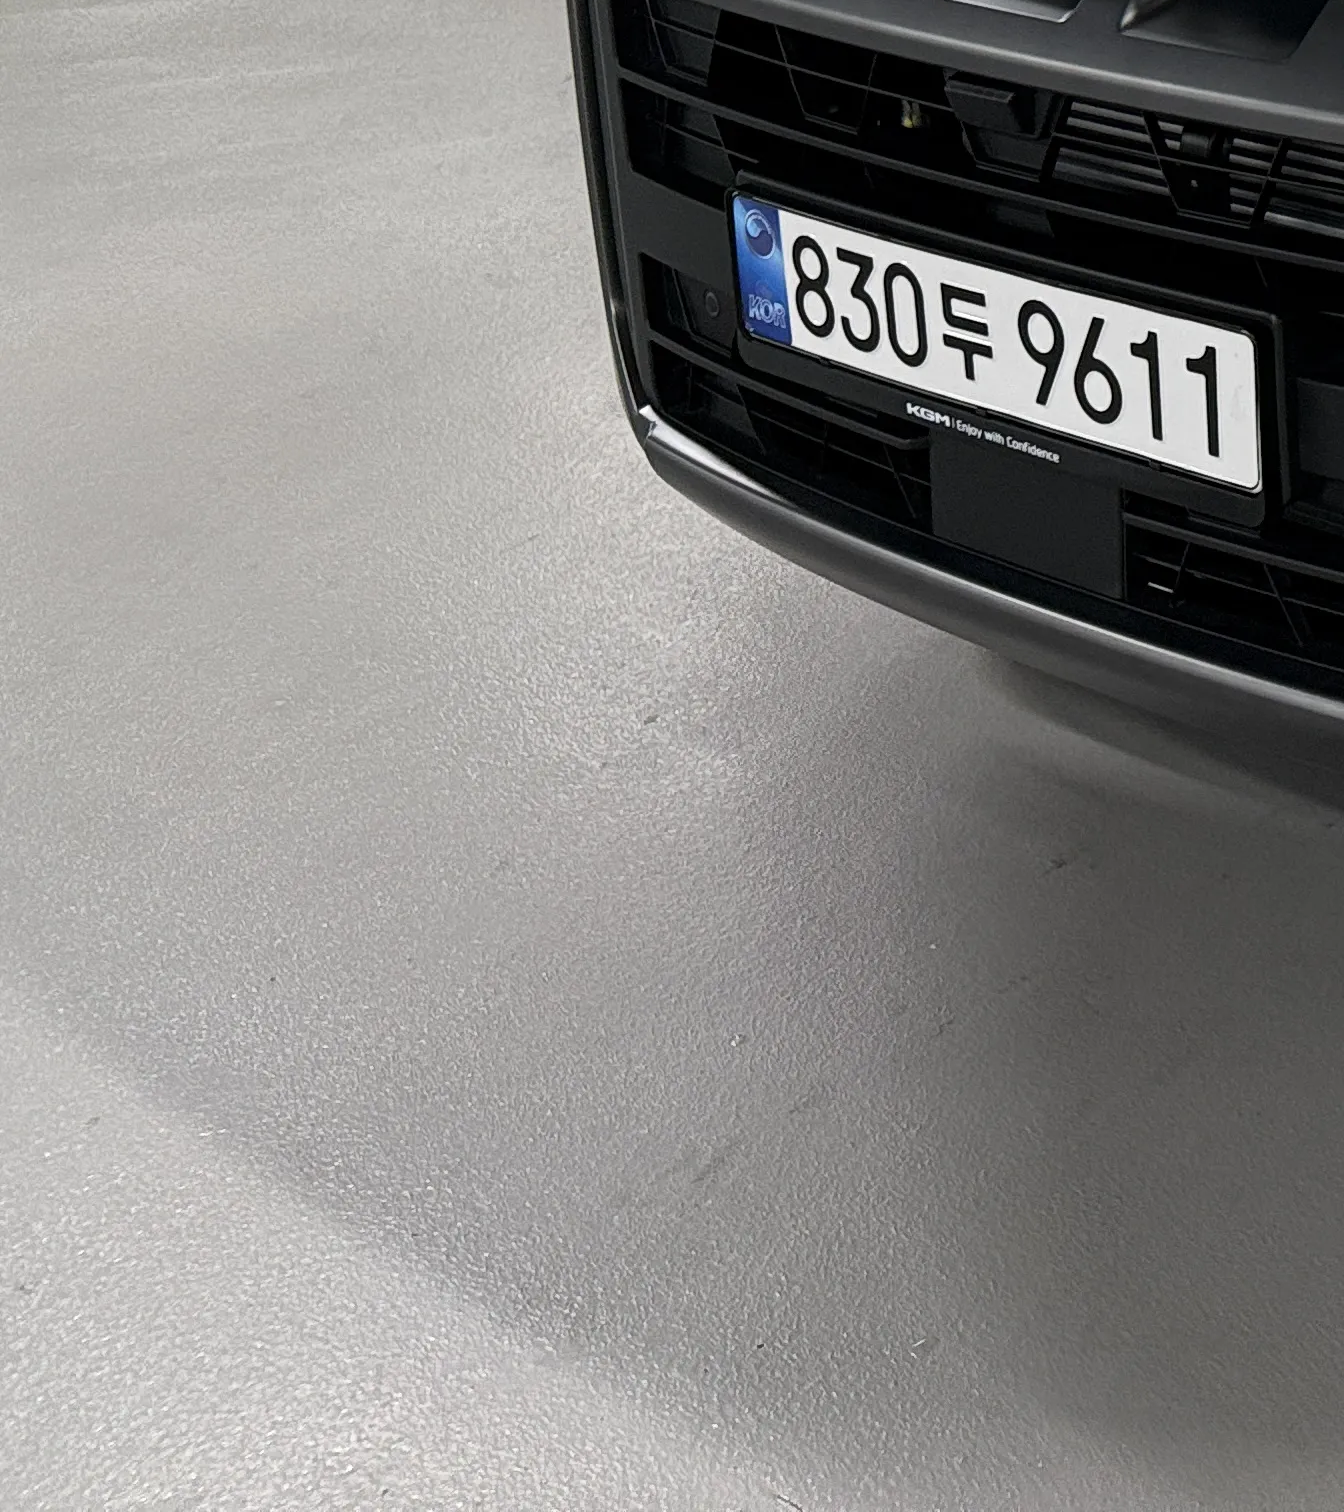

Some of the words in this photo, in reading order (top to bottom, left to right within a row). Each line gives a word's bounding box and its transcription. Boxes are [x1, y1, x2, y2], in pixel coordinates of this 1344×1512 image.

[748, 294, 787, 329] KOR
[906, 402, 950, 427] KGM
[956, 420, 983, 439] Enjoy
[984, 430, 1005, 446] with
[1006, 436, 1060, 464] Confidence
